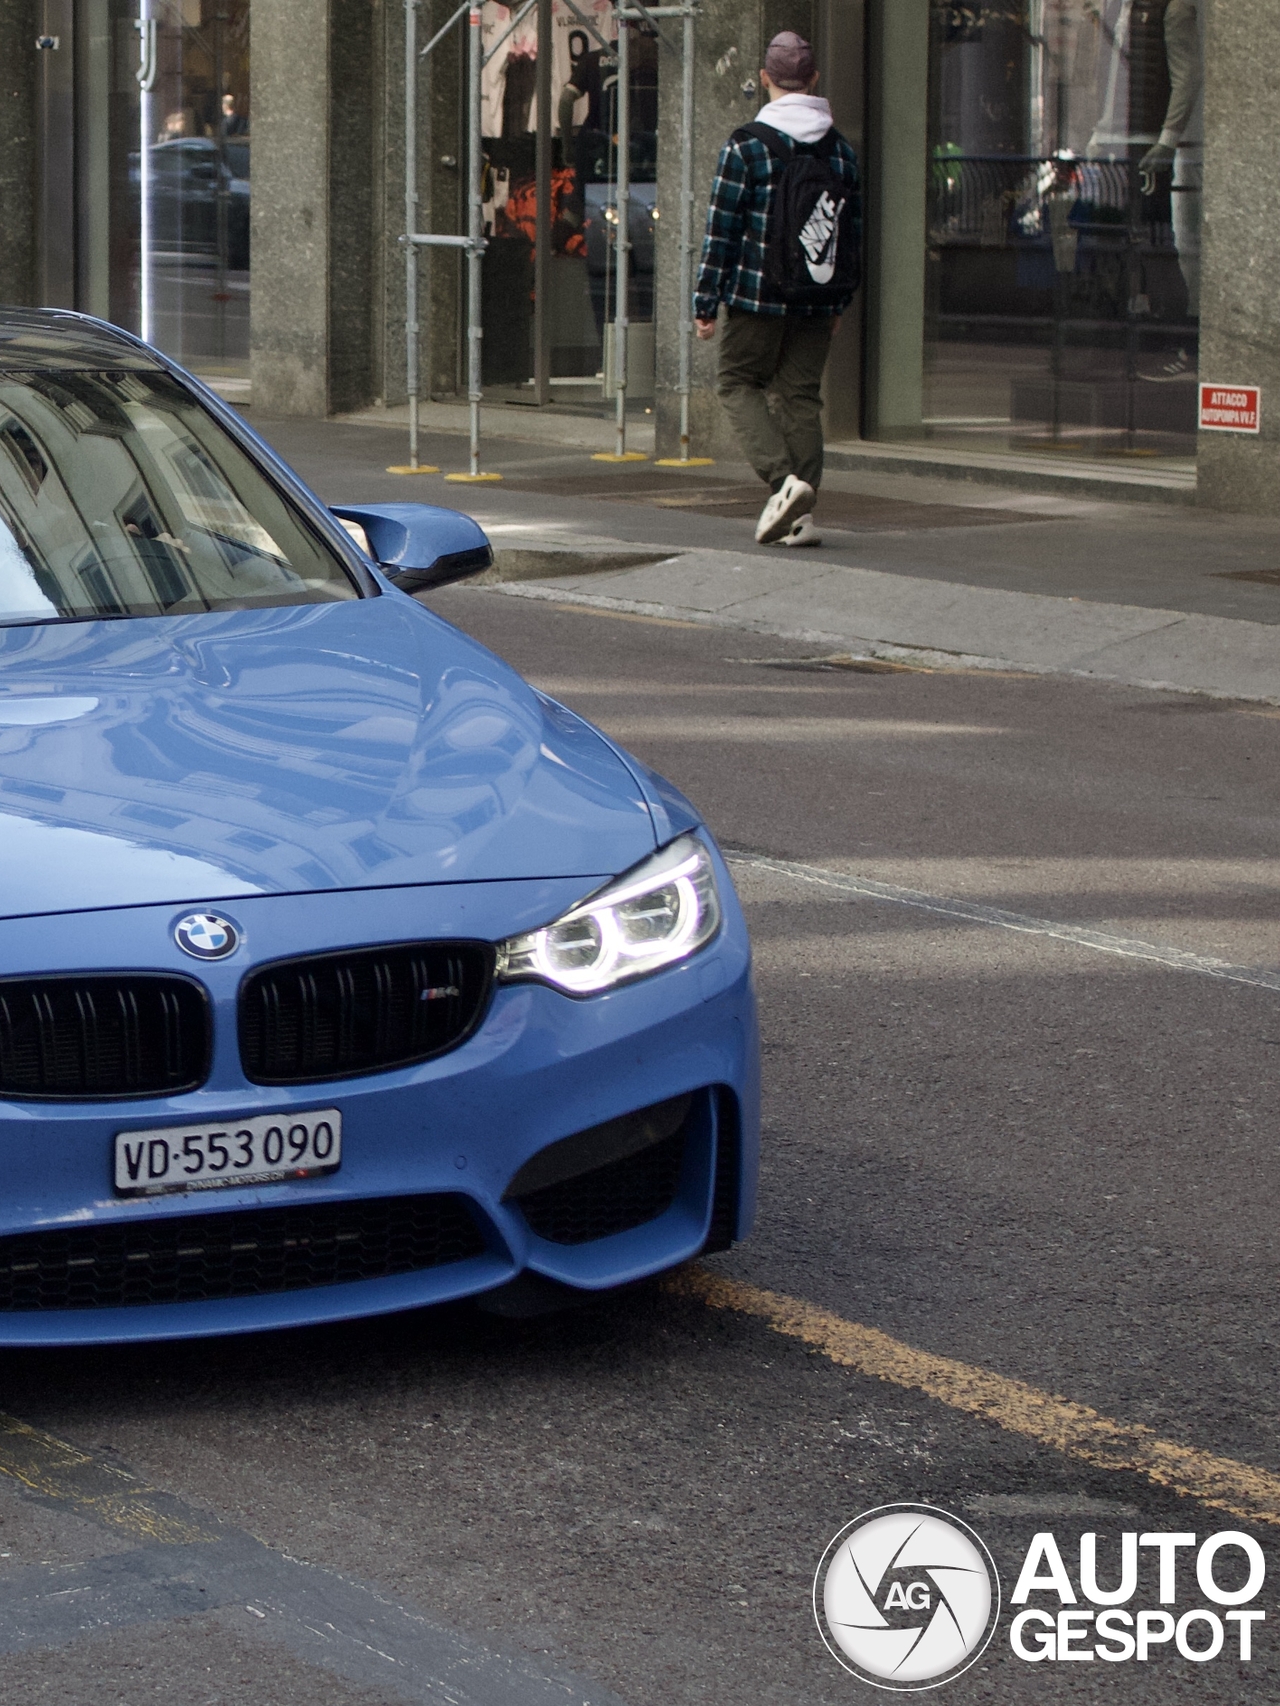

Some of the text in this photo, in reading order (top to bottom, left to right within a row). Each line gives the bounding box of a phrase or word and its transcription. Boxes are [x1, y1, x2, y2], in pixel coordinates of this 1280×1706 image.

[799, 190, 836, 262] NIKE
[1211, 392, 1248, 407] ATTACCO
[1202, 408, 1239, 424] AUTOPOMPA
